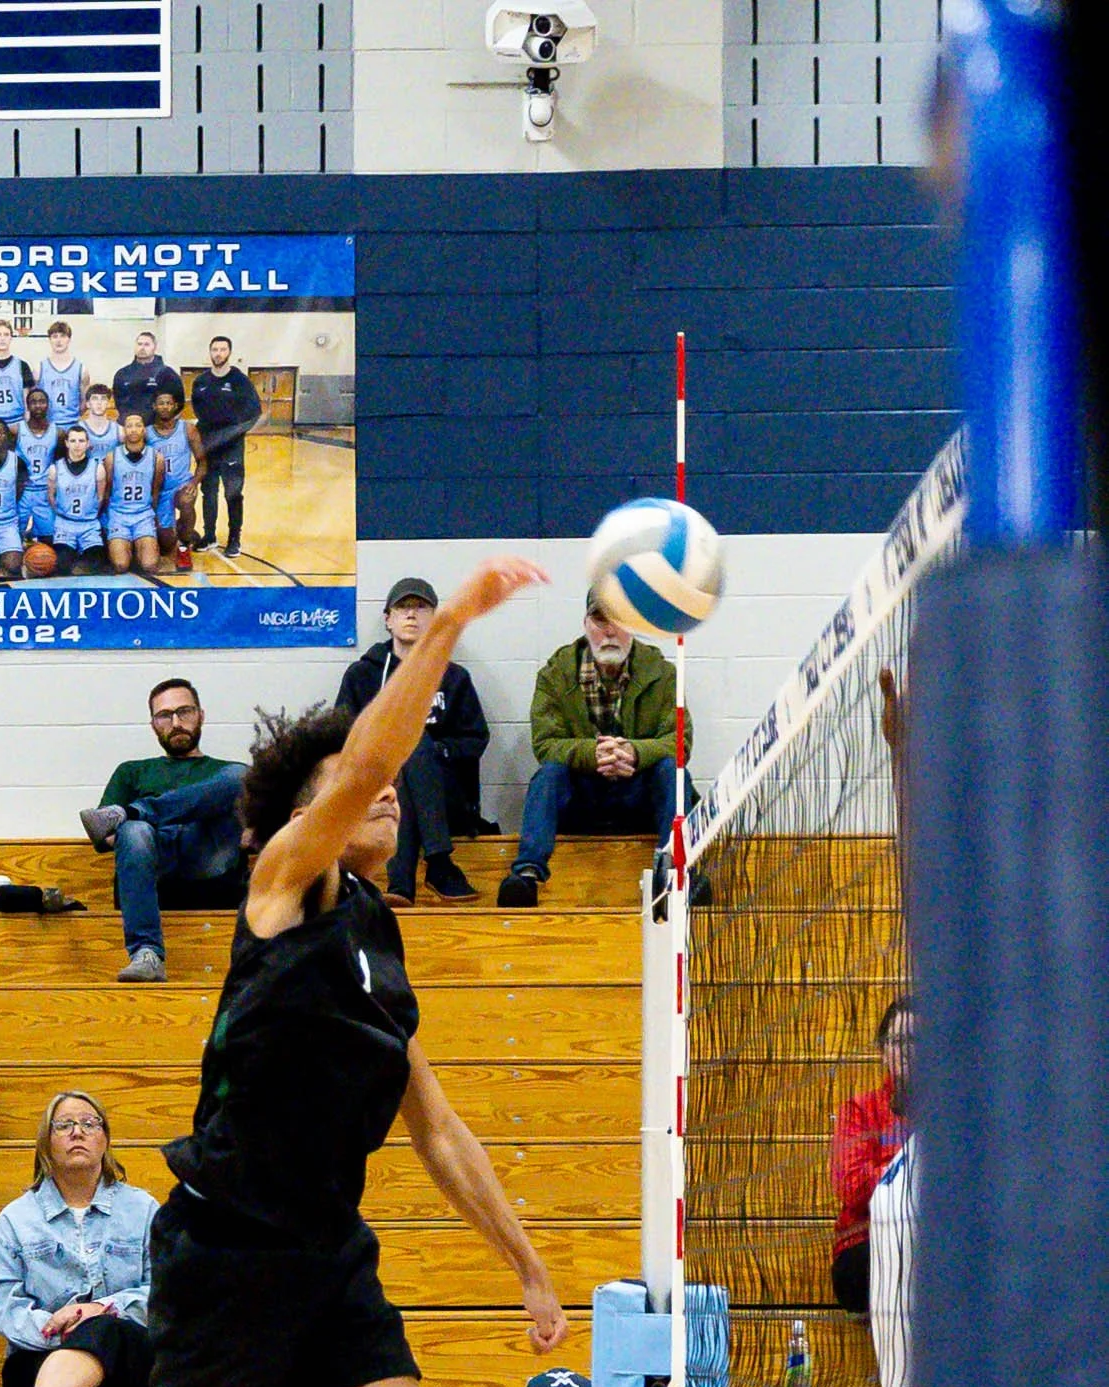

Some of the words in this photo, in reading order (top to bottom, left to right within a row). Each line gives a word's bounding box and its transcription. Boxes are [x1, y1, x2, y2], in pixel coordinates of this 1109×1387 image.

[113, 243, 240, 266] MOTT
[56, 392, 66, 406] 4
[32, 459, 41, 473] 5
[124, 486, 143, 501] 22
[72, 499, 81, 513] 2
